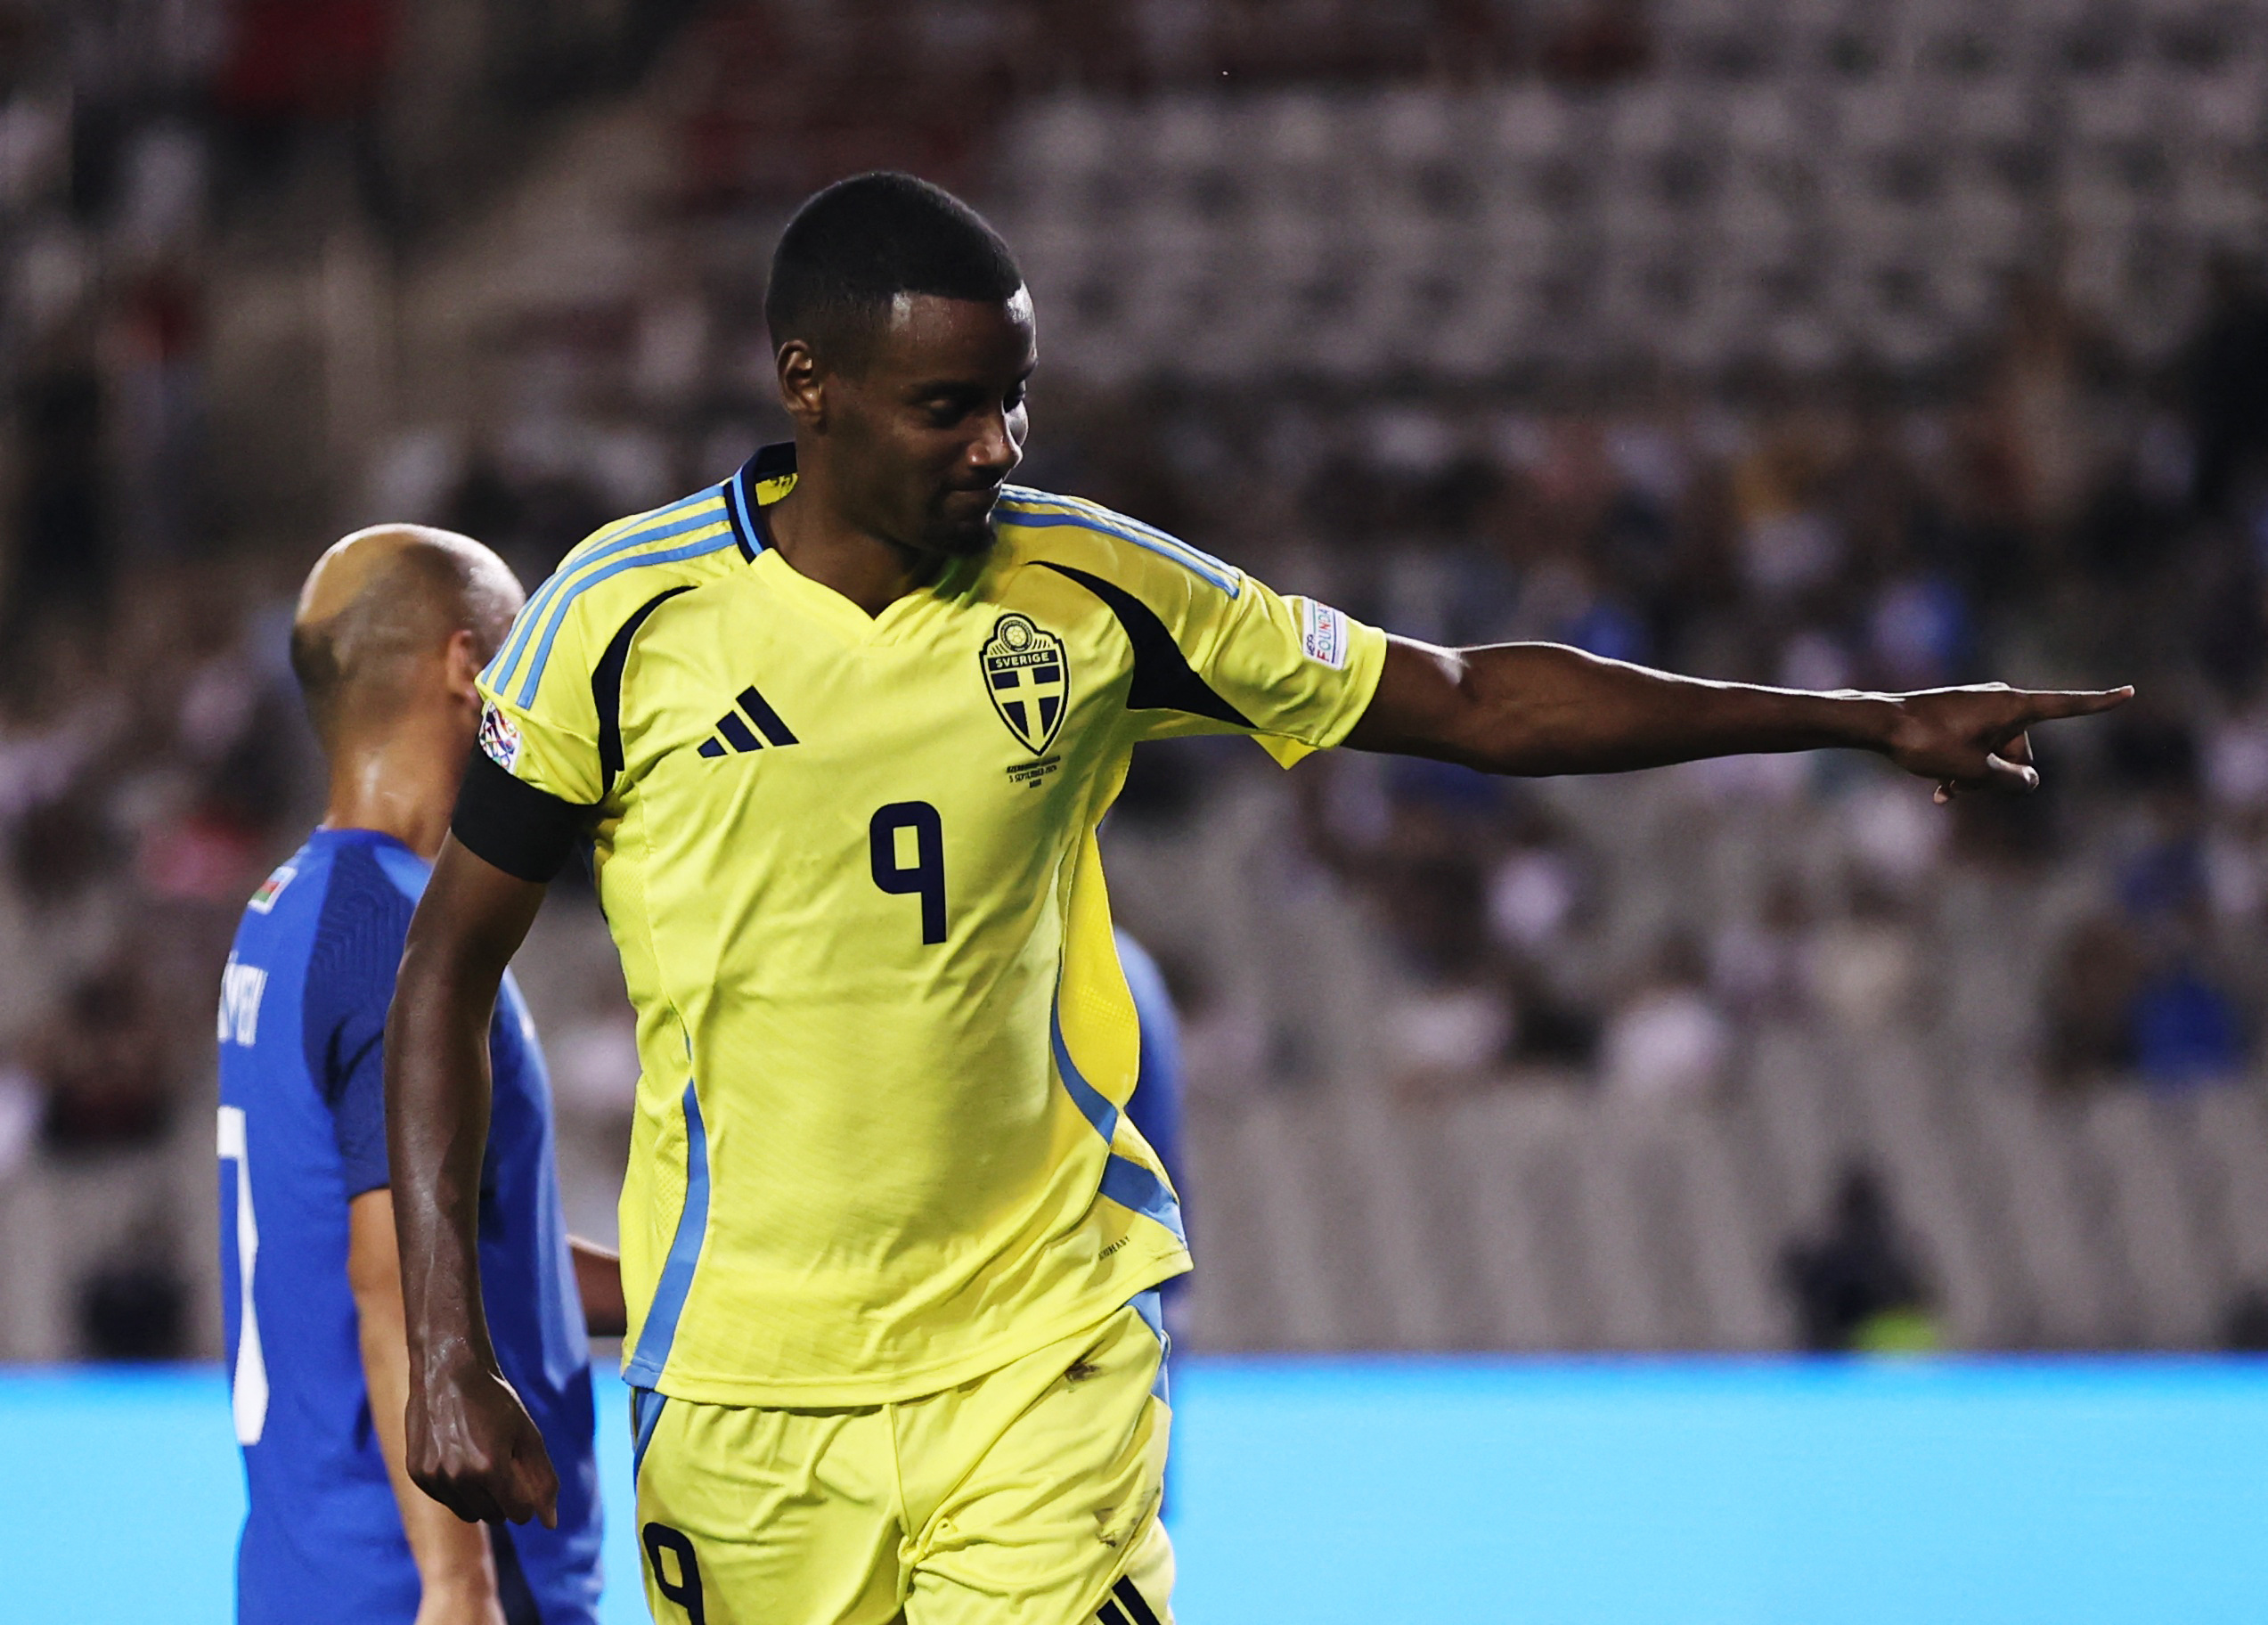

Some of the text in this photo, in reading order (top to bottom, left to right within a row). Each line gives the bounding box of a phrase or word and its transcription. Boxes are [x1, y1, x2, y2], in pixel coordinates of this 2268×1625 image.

[995, 651, 1050, 668] SVERIGE
[869, 800, 946, 945] 9
[642, 1522, 706, 1625] 9
